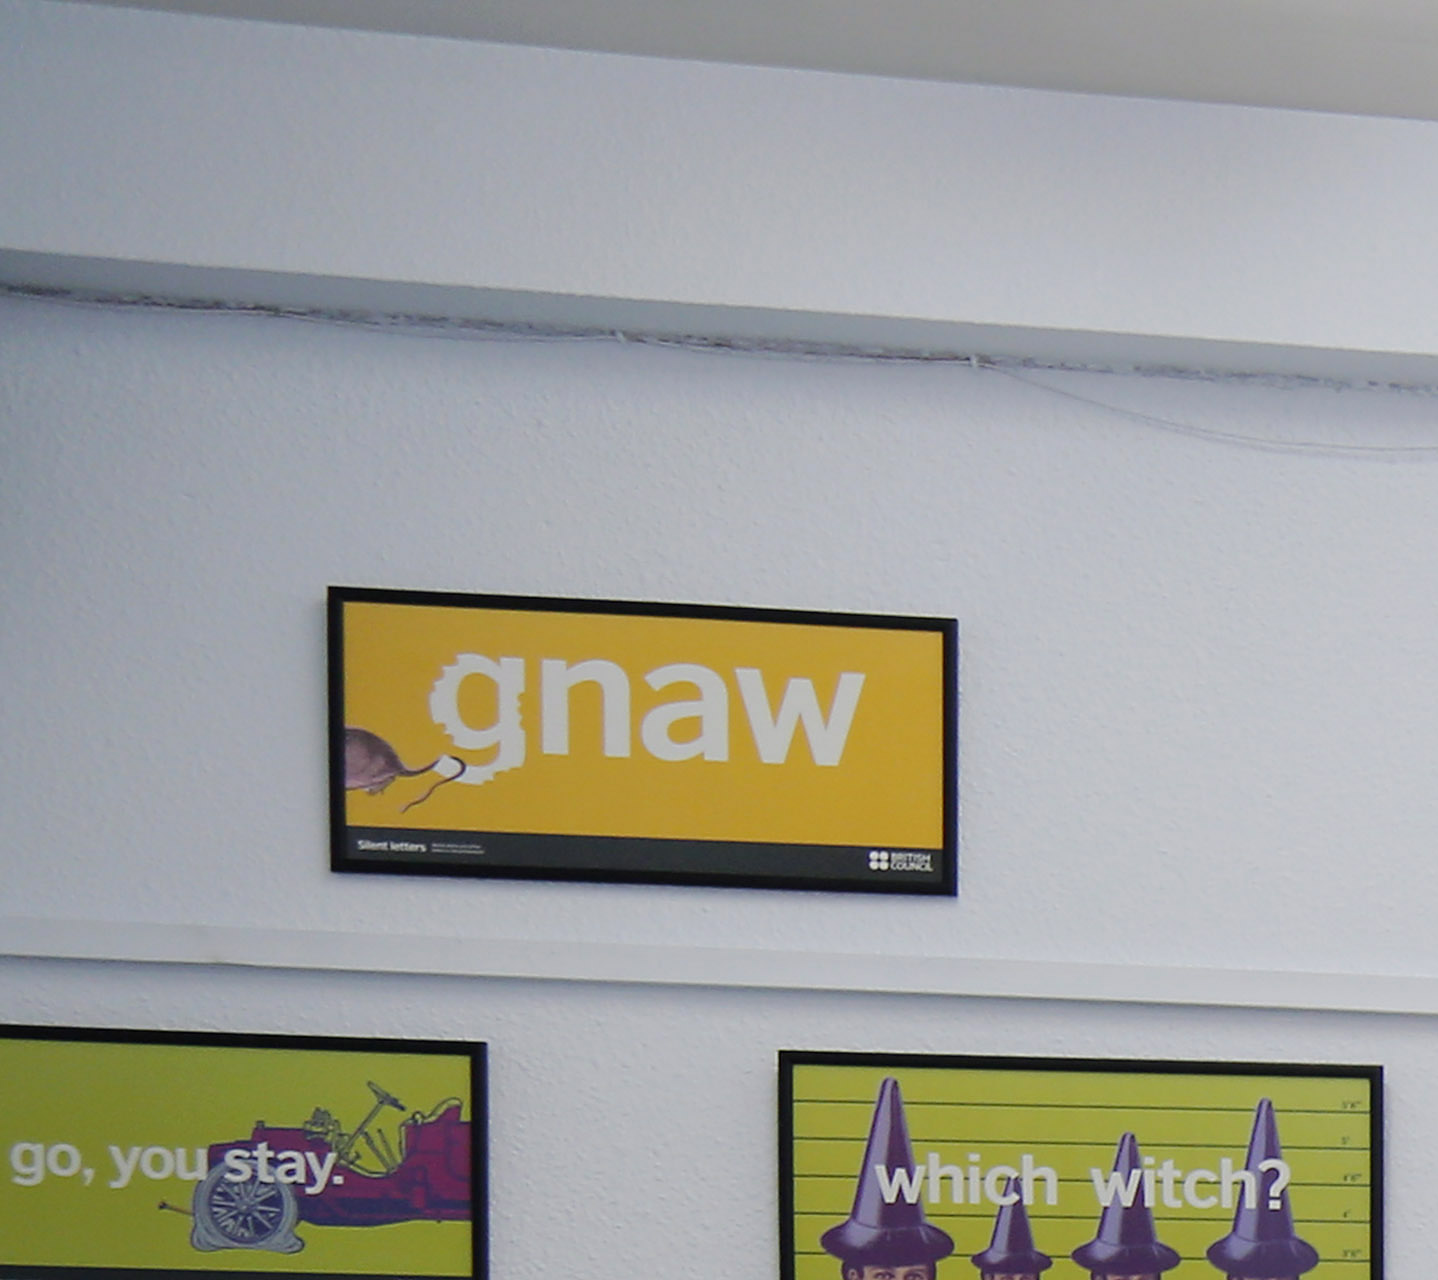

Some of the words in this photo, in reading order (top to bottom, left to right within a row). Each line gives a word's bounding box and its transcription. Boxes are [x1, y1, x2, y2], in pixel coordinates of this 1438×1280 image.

[429, 652, 865, 786] gnaw
[390, 841, 427, 853] letters
[891, 852, 931, 862] BRITISH
[891, 861, 934, 872] COUNCIL
[10, 1141, 95, 1186] go,
[109, 1144, 207, 1188] you
[223, 1141, 344, 1195] stay.
[874, 1152, 1058, 1206] which
[1091, 1156, 1291, 1211] witch?
